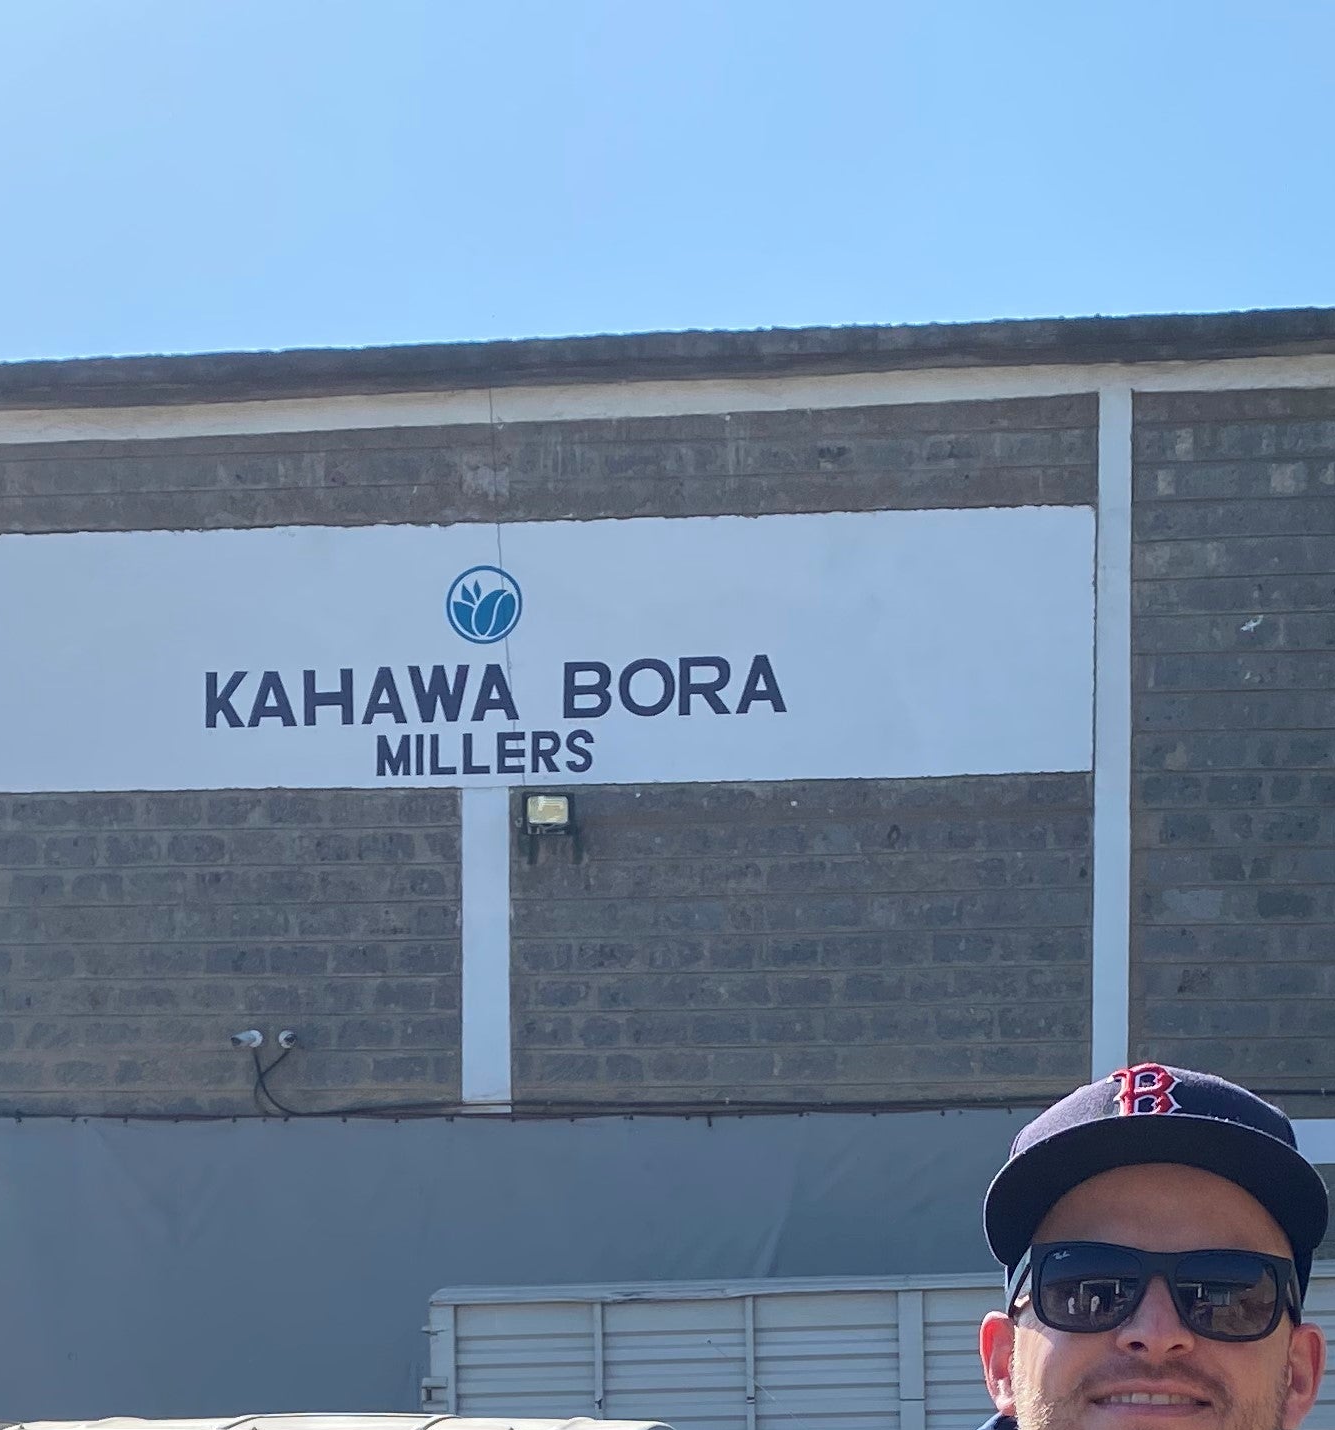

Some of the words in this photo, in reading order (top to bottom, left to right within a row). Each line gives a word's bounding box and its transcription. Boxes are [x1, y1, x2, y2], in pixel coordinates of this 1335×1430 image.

[204, 663, 520, 728] KAHAWA
[563, 654, 788, 719] BORA
[375, 729, 594, 776] MILLERS
[1105, 1062, 1182, 1117] B
